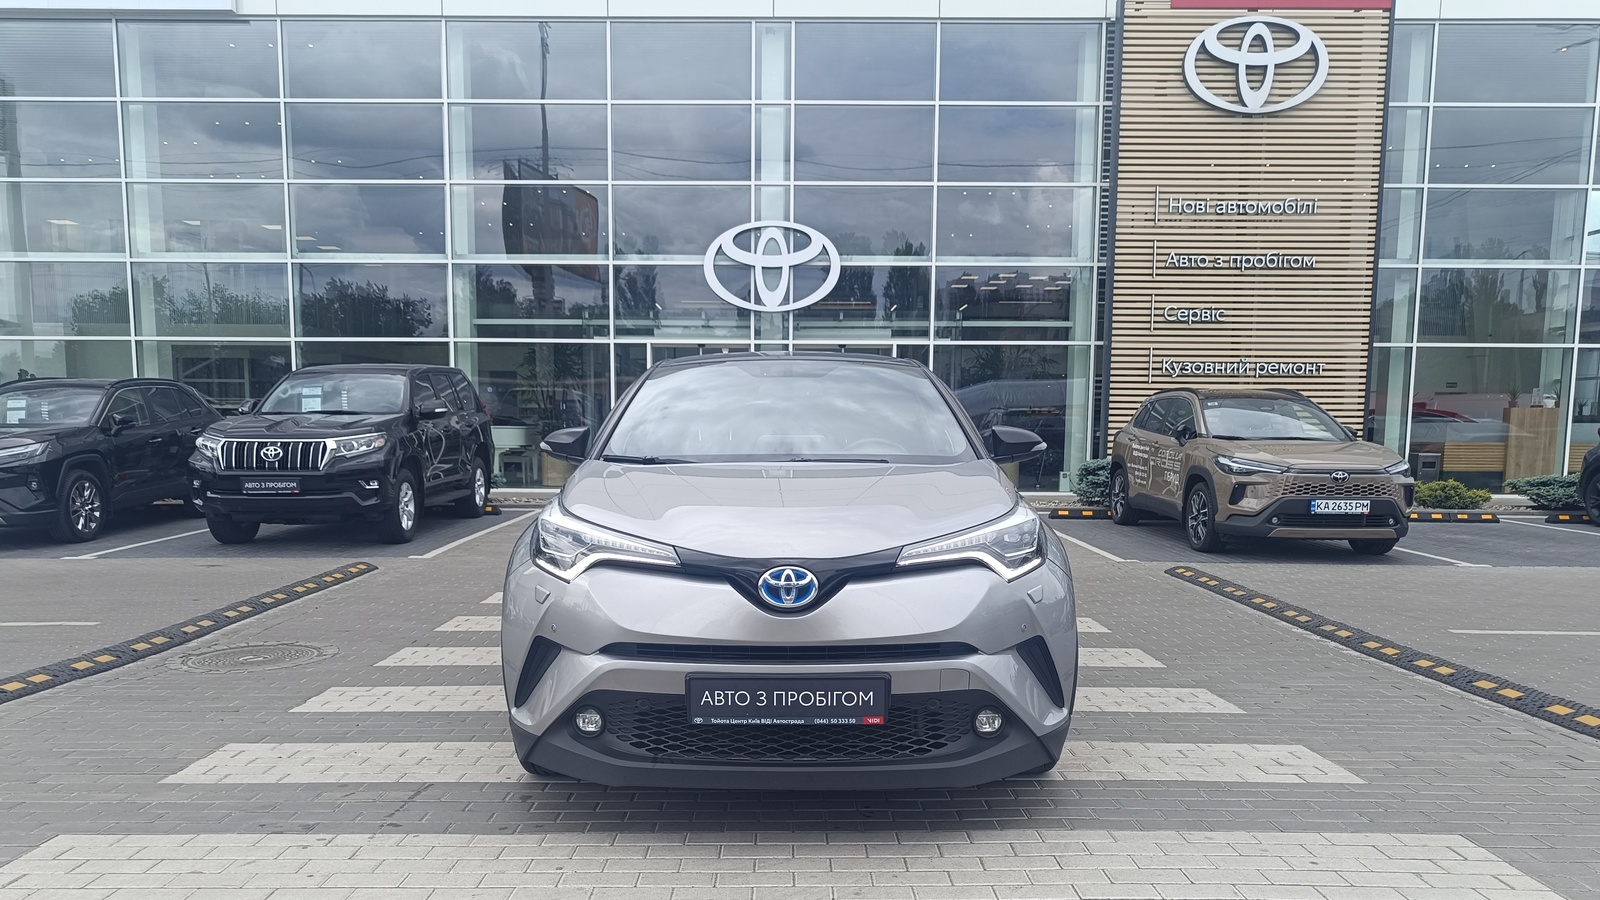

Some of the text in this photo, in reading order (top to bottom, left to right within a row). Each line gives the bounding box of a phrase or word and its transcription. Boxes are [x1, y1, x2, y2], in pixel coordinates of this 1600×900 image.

[1168, 197, 1318, 214] Нові автомобілі
[1165, 252, 1316, 272] Авто з пробігом
[1163, 305, 1226, 325] Сервіс
[1161, 358, 1326, 378] Кузовний ремонт
[700, 690, 874, 706] АВТО З ПРОБІГОМ
